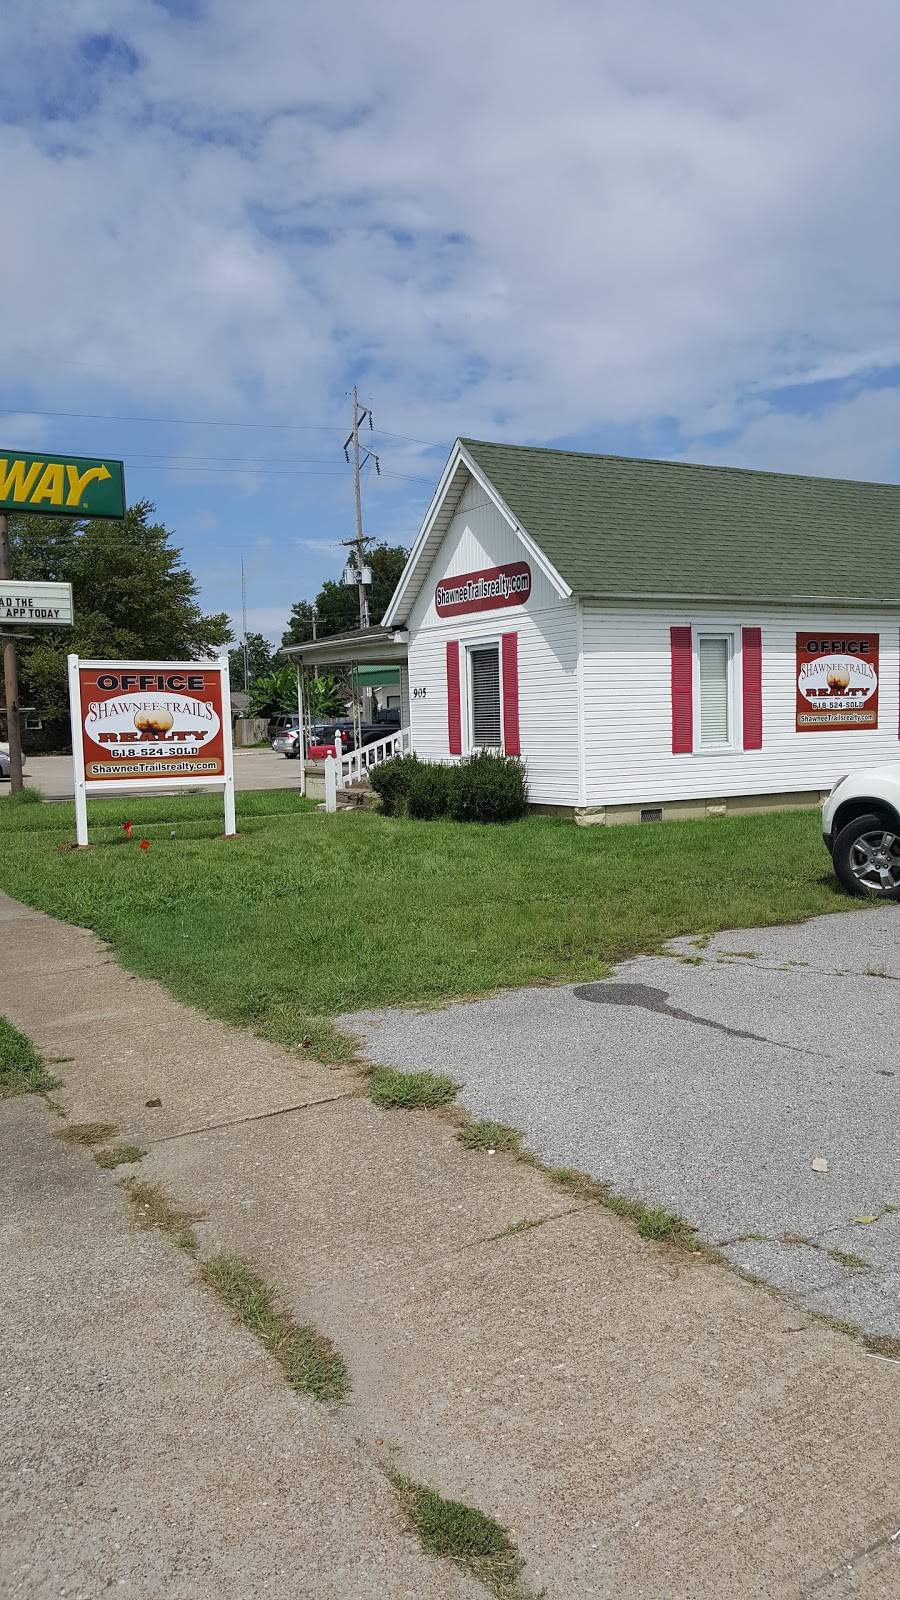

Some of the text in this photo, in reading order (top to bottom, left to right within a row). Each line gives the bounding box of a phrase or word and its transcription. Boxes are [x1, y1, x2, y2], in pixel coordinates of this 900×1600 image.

[0, 459, 111, 506] WAY
[437, 573, 529, 606] ShawneeTrailsrealty.com
[15, 598, 33, 607] THE
[6, 608, 60, 618] APP TODAY
[807, 641, 871, 654] OFFICE
[801, 663, 875, 680] SHAWNEE TRAILS
[97, 674, 205, 691] OFFICE
[413, 687, 427, 698] 905
[805, 687, 870, 697] REALTY
[812, 701, 864, 709] 618-524-SOLD
[89, 702, 213, 722] SHAWNEE TRAILS
[801, 713, 873, 724] ShawneeTrailsrealty.com
[98, 731, 209, 743] REALTY
[112, 746, 199, 758] 618-524-SOLD
[92, 761, 217, 774] ShawneeTrailsrealty.com
